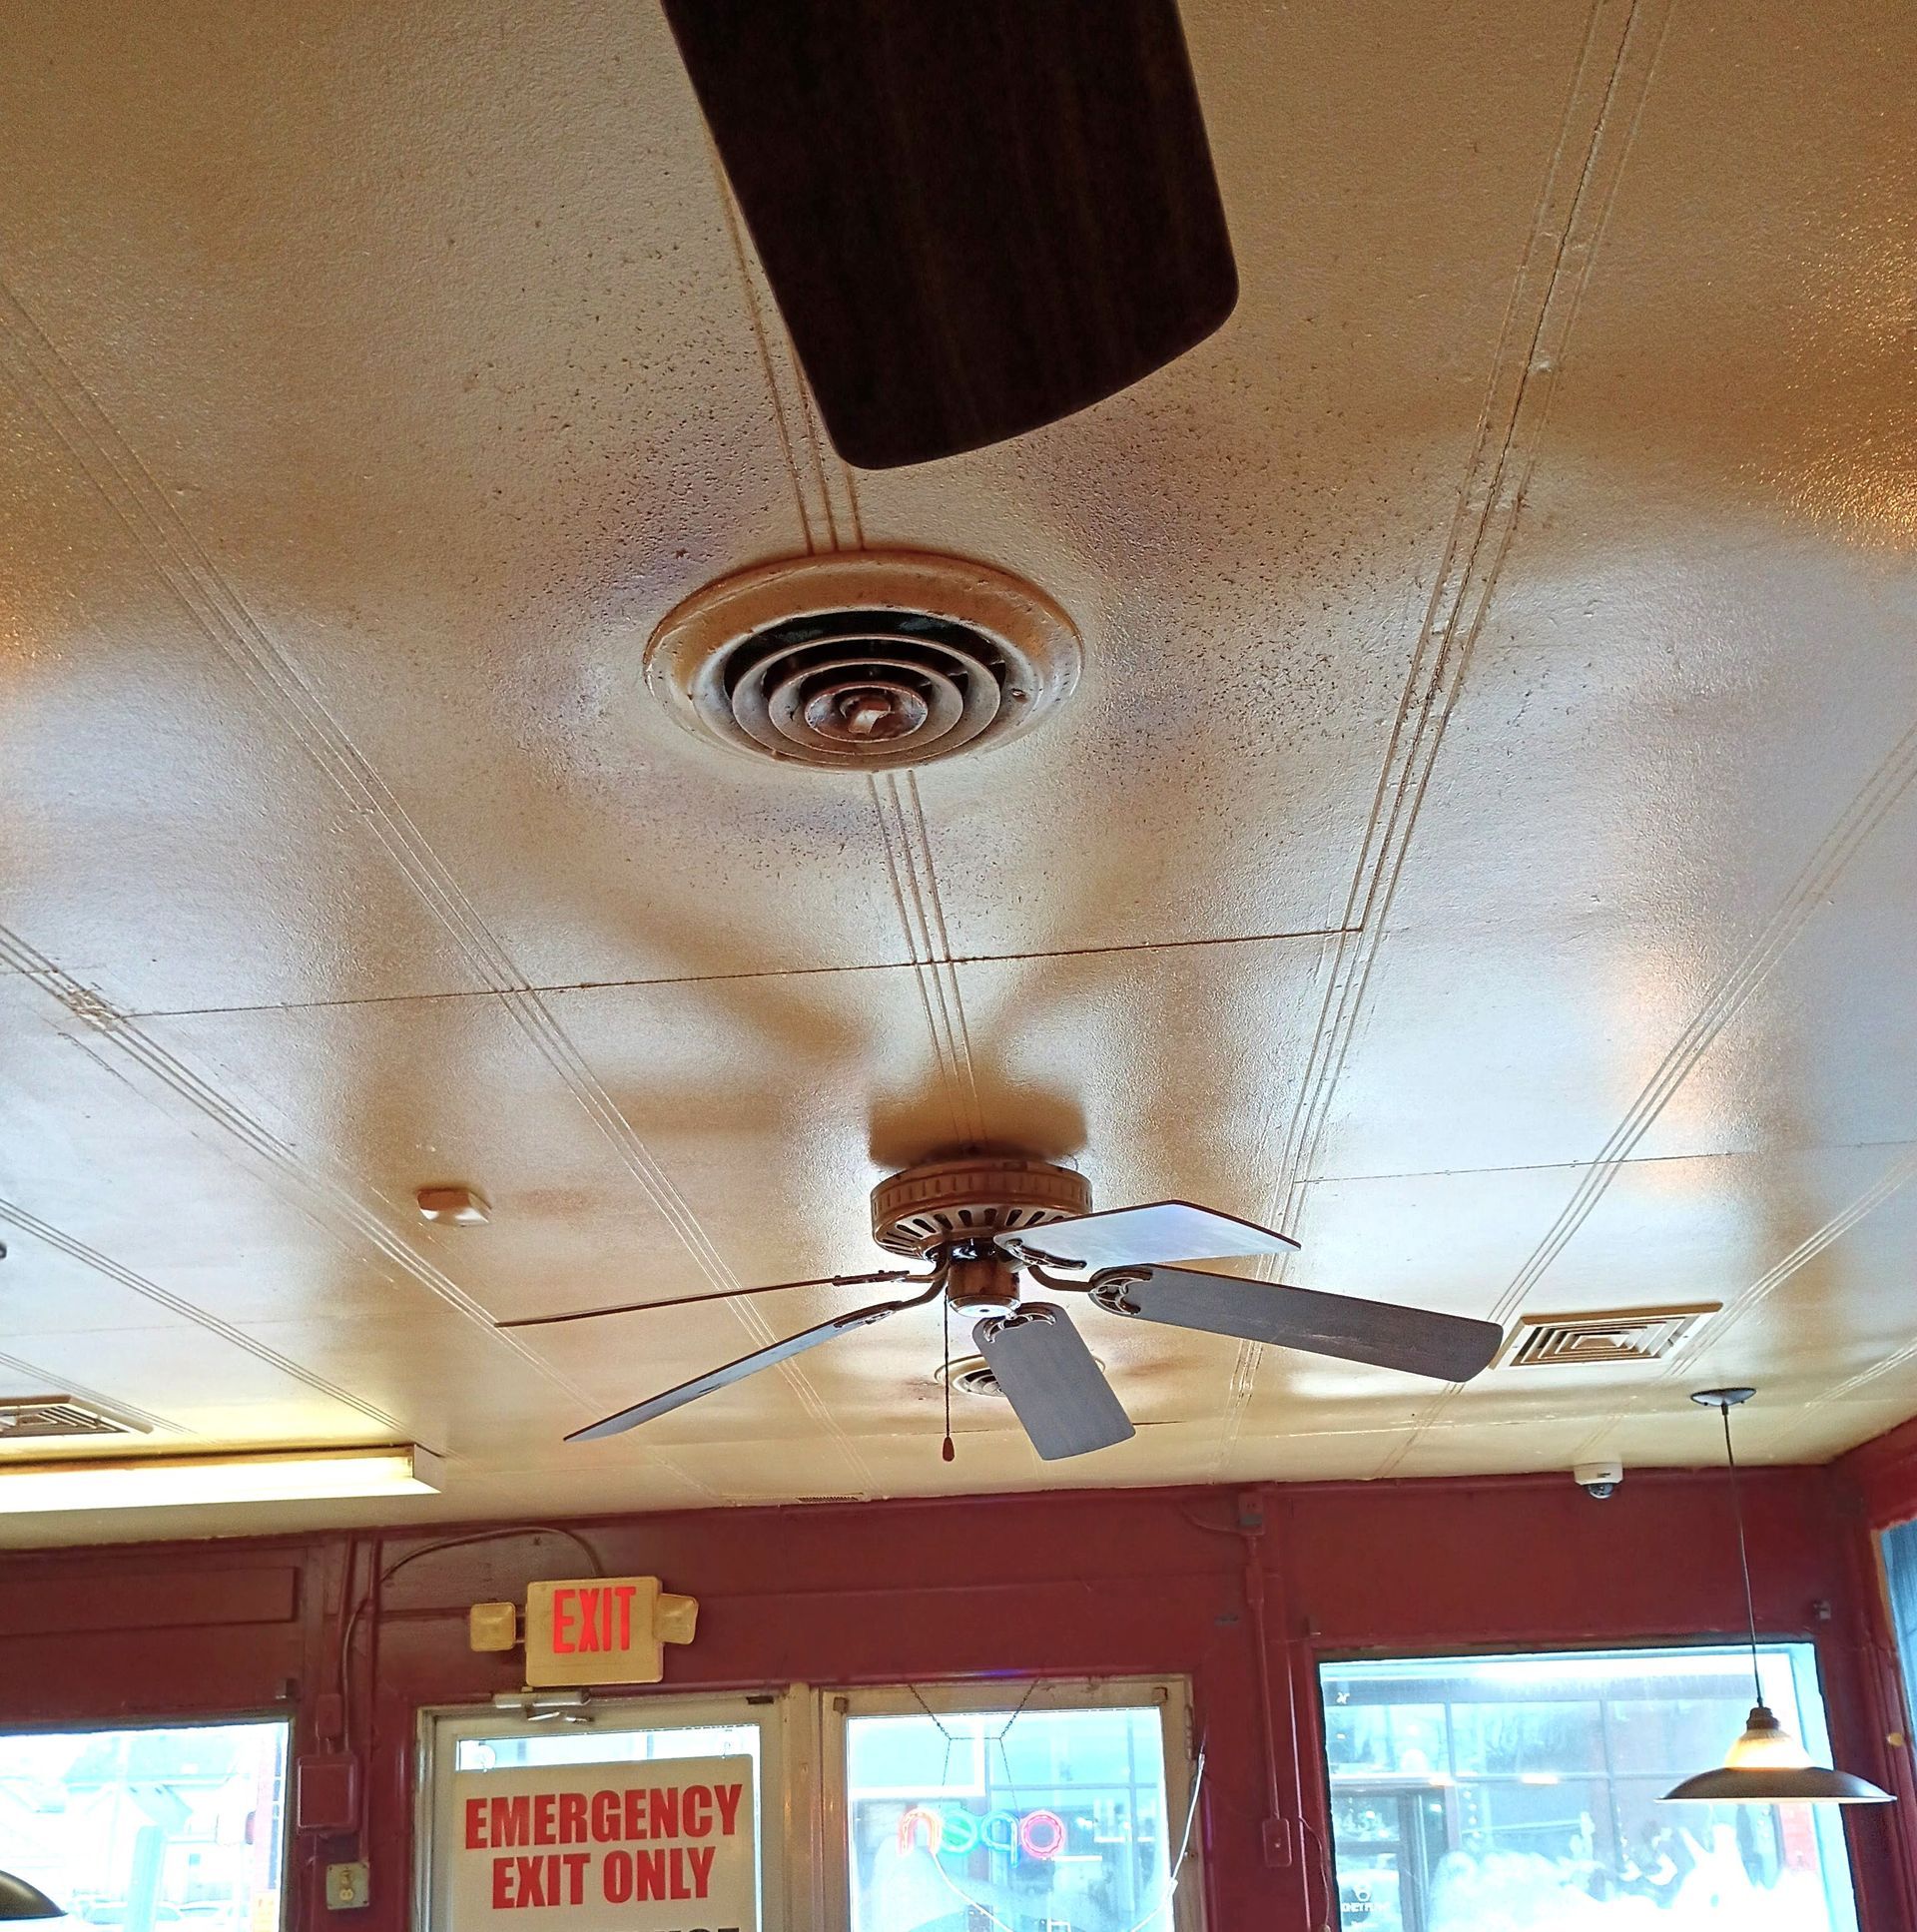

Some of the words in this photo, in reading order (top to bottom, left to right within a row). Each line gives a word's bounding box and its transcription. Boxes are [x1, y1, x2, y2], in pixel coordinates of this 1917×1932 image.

[553, 1586, 636, 1653] EXIT
[465, 1784, 743, 1849] EMERGENCY
[492, 1853, 591, 1909] EXIT
[603, 1846, 716, 1904] ONLY
